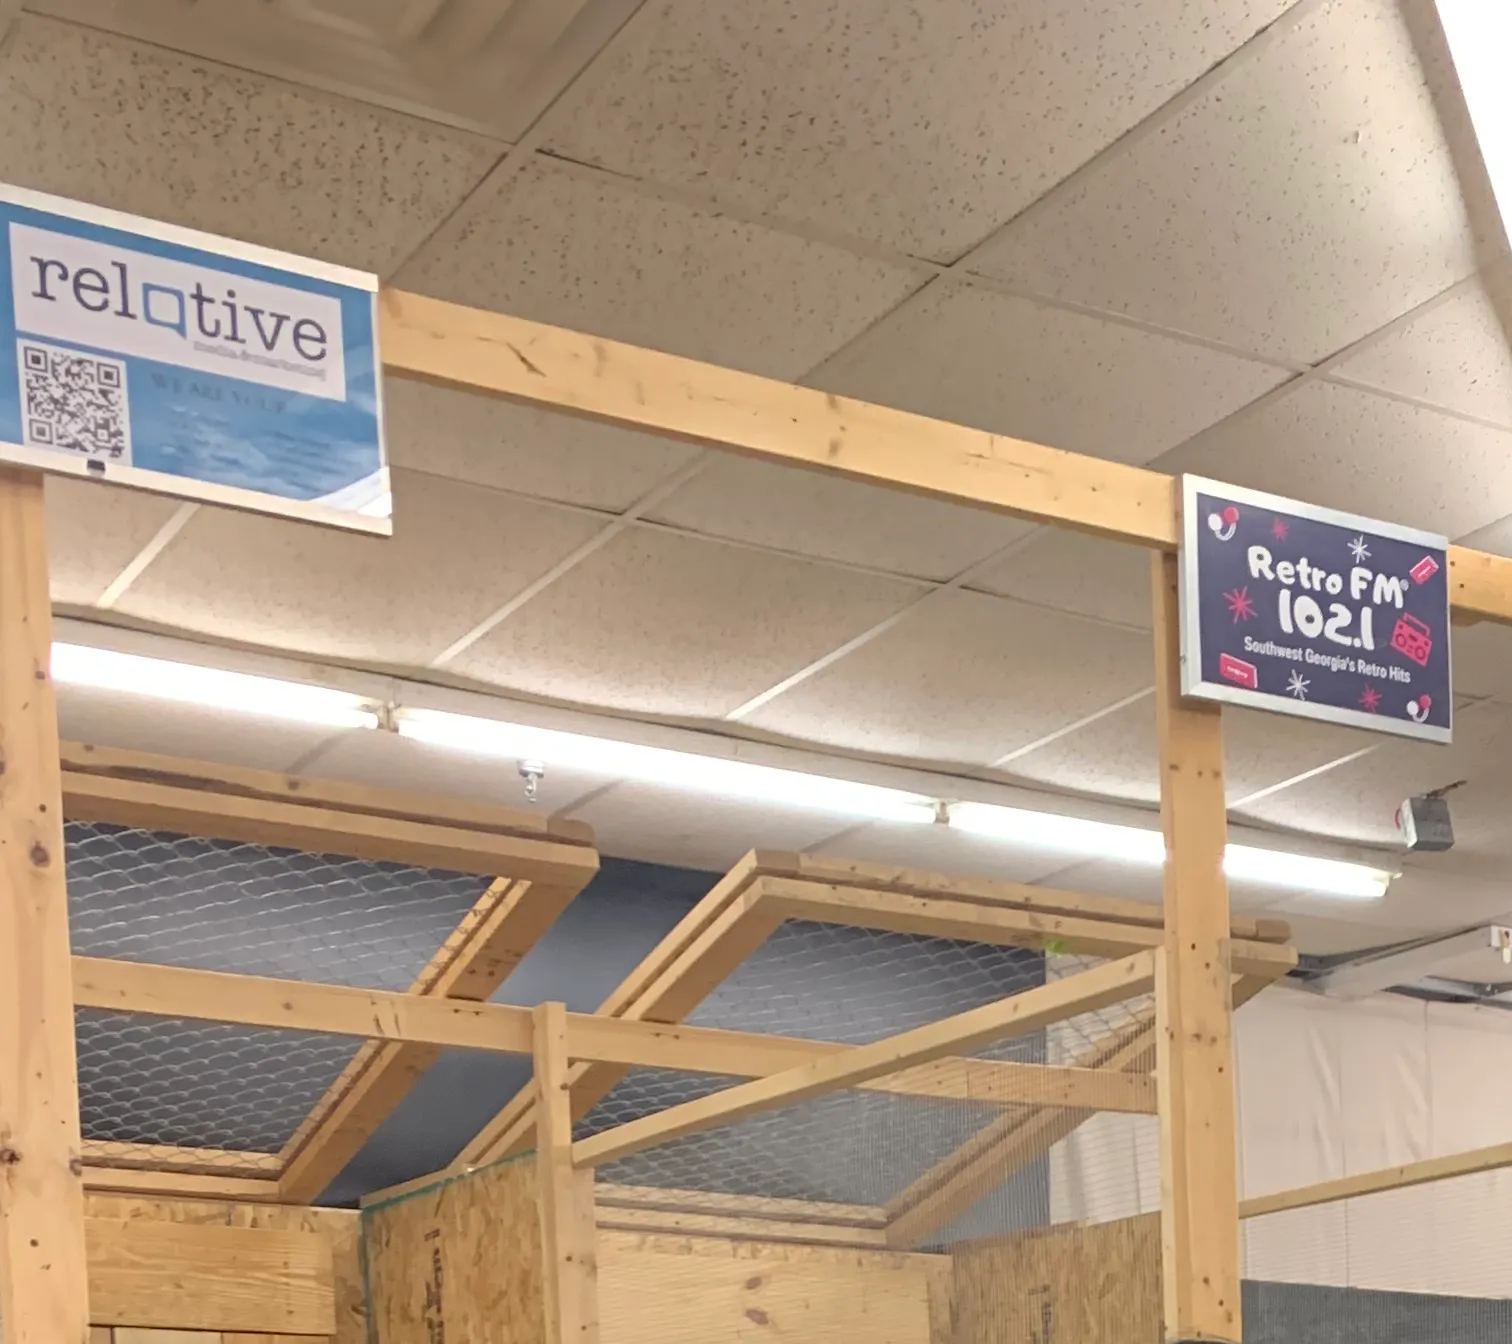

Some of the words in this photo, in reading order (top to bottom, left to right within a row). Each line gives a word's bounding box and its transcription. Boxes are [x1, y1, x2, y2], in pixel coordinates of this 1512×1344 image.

[1247, 545, 1344, 595] Retro
[1350, 566, 1404, 609] FM
[1278, 588, 1375, 651] 102.1
[1243, 635, 1304, 663] Southwest
[1305, 647, 1356, 673] Georgia's
[1357, 659, 1388, 679] Retro
[1388, 665, 1412, 684] Hits
